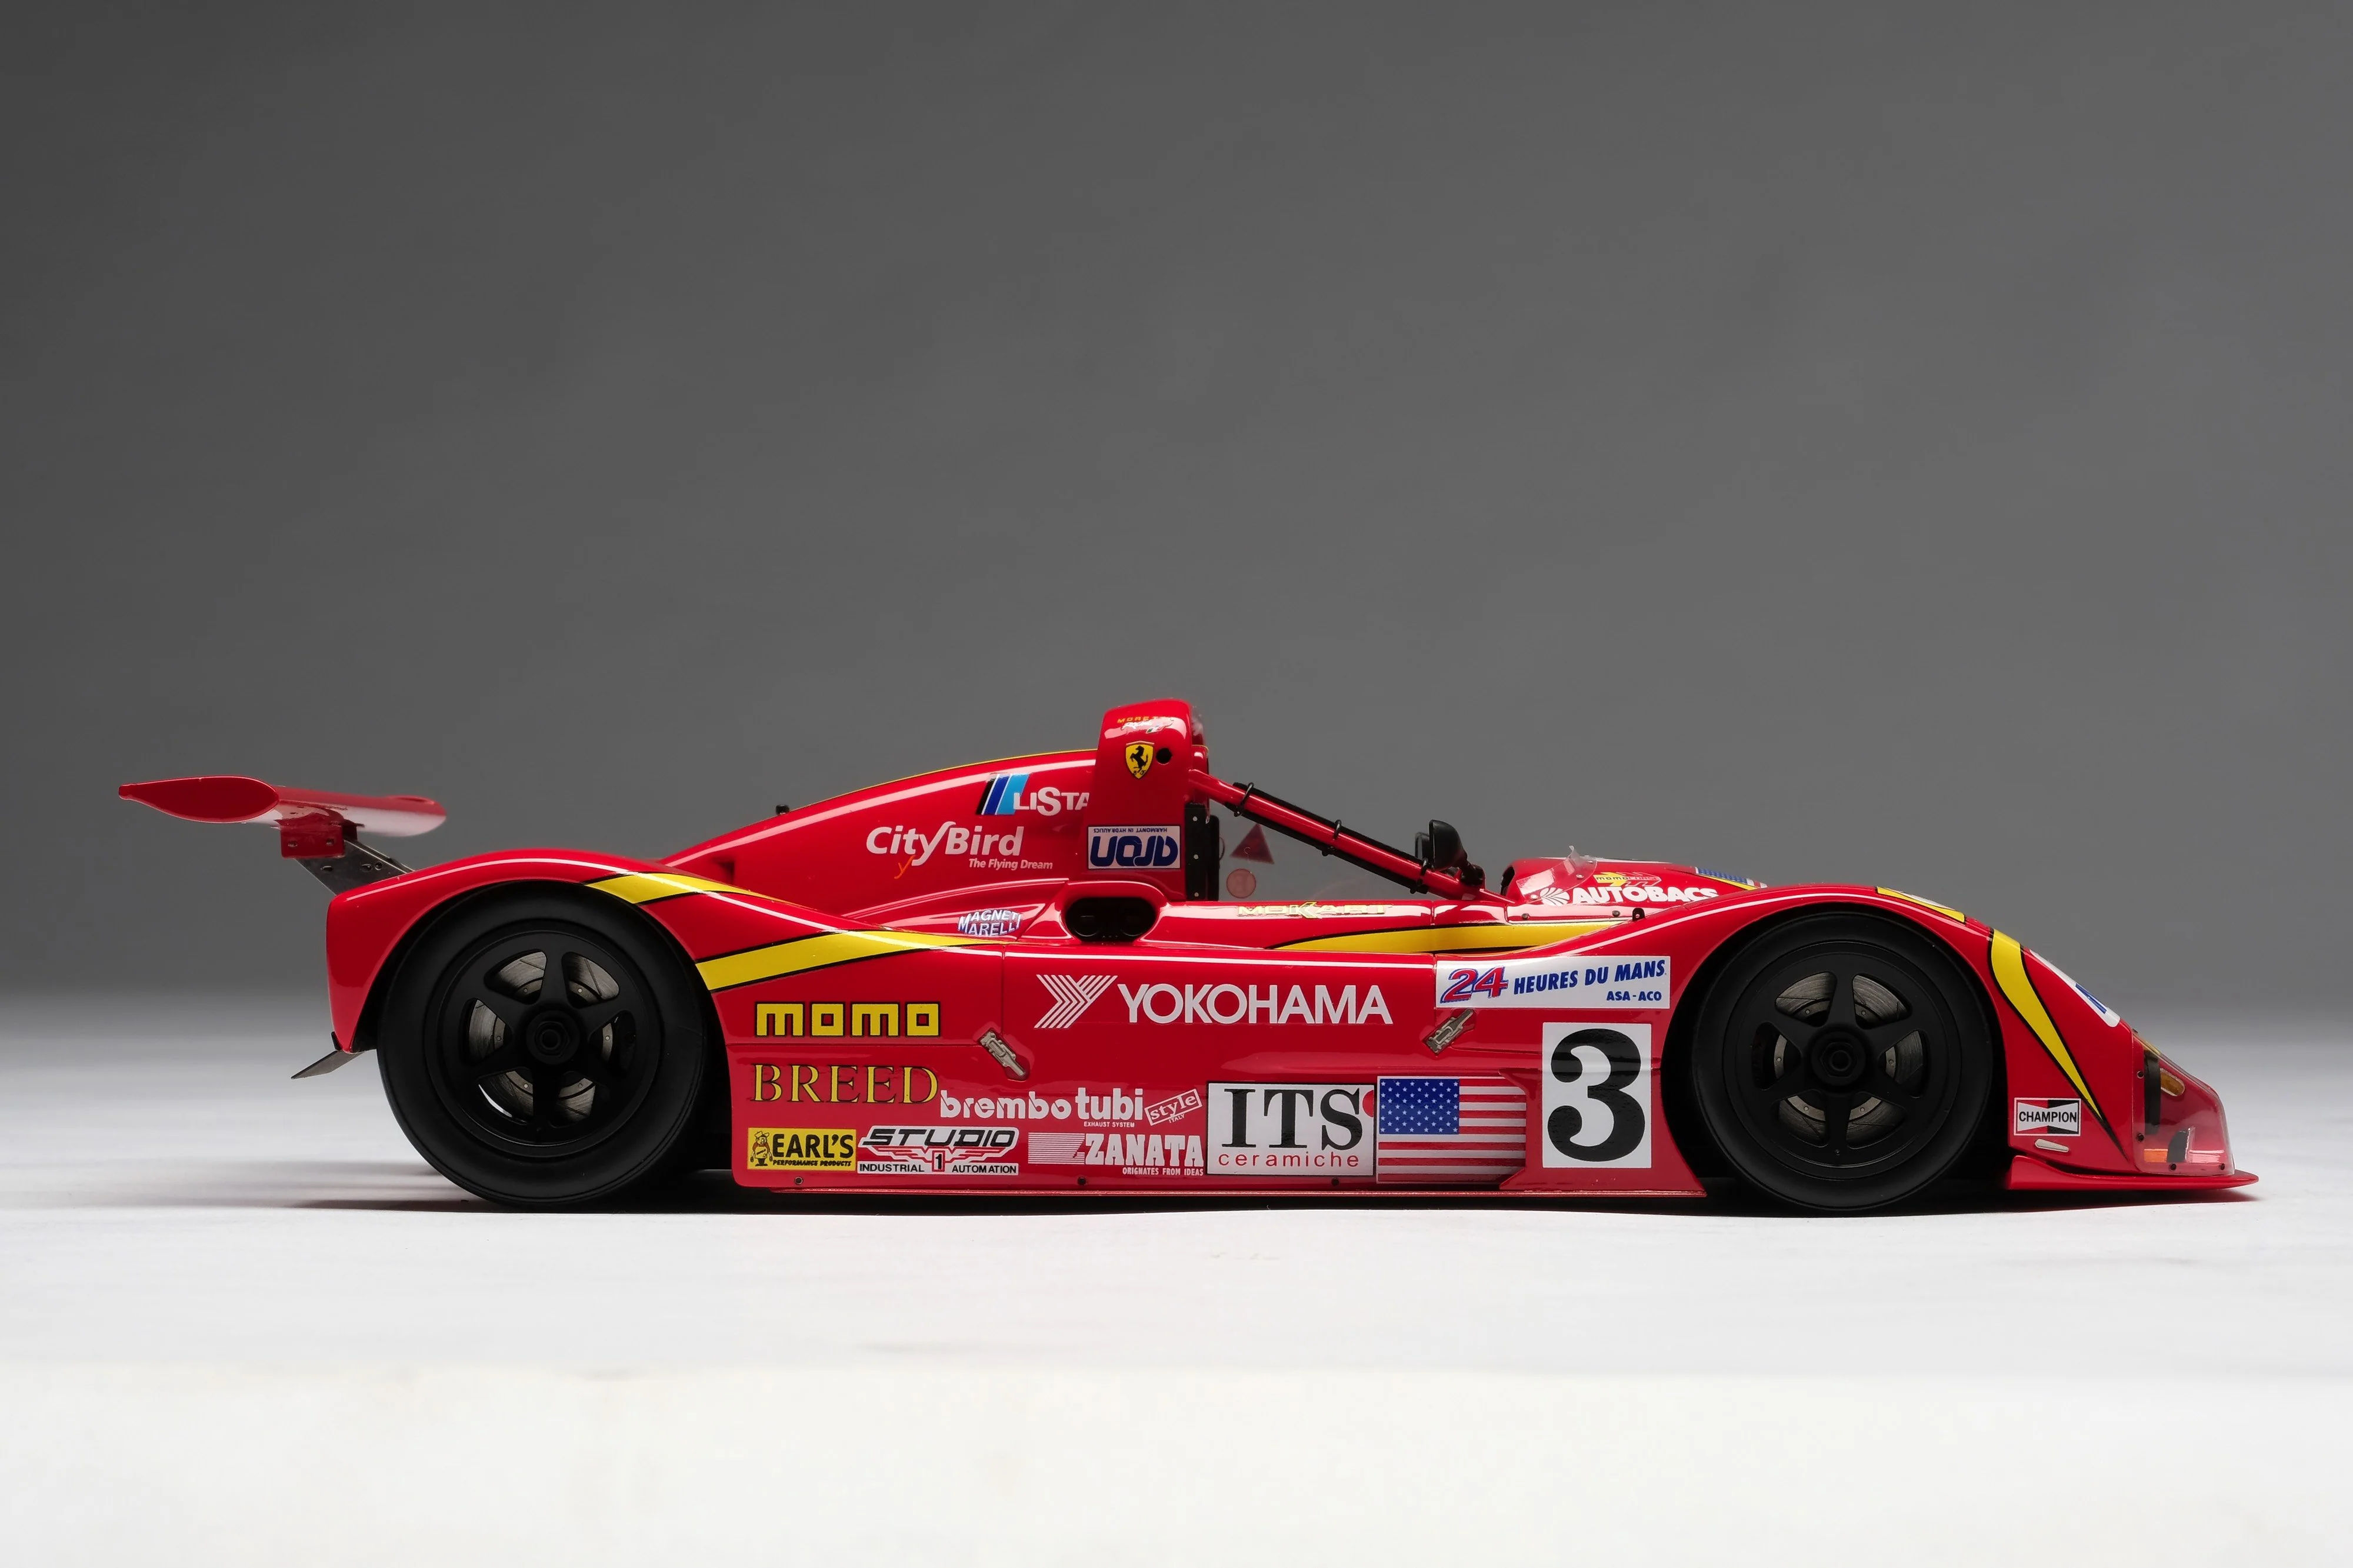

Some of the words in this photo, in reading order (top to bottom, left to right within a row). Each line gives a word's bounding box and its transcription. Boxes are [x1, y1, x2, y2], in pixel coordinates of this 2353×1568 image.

[866, 821, 1024, 866] CityBird
[969, 858, 986, 868] The
[988, 859, 1018, 870] Flying
[1020, 859, 1053, 869] Dream
[1572, 886, 1719, 905] AUTOBACS
[1439, 966, 1508, 1003] 24
[1514, 970, 1578, 995] HEURES
[1585, 966, 1609, 986] DU
[1614, 960, 1665, 982] MANS
[1118, 983, 1394, 1025] YOKOHAMA
[751, 1063, 939, 1104] BREED
[1547, 1028, 1645, 1162] 3
[940, 1090, 1072, 1119] brembo
[1075, 1087, 1143, 1120] tubi
[1149, 1095, 1197, 1120] style
[1168, 1113, 1185, 1123] ITALY
[1221, 1088, 1363, 1150] ITS
[2019, 1111, 2077, 1123] CHAMPION
[772, 1133, 854, 1159] EARL'S
[862, 1129, 1015, 1147] STUDIO
[1085, 1133, 1204, 1167] ZANATA
[859, 1163, 925, 1172] INDUSTRIAL
[952, 1165, 1016, 1173] AUTOMATION
[935, 1154, 942, 1169] 1
[1162, 1167, 1181, 1176] FROM
[1184, 1168, 1204, 1176] IDEAS
[1218, 1151, 1359, 1167] ceramiche
